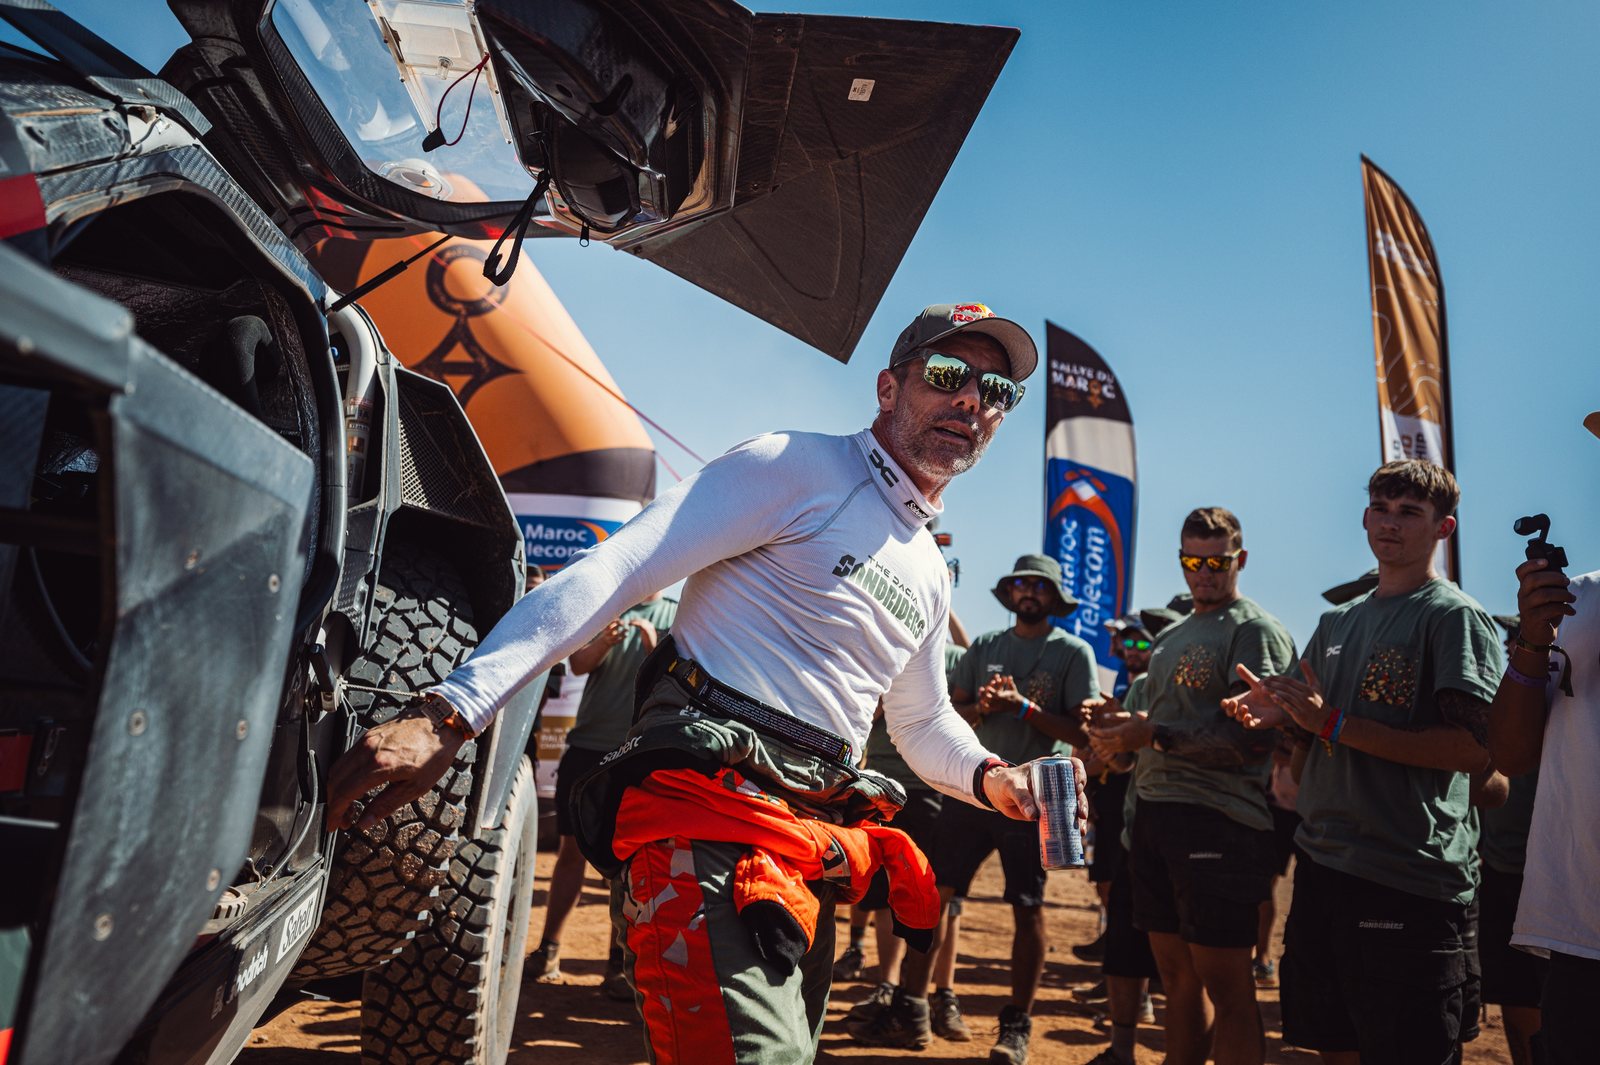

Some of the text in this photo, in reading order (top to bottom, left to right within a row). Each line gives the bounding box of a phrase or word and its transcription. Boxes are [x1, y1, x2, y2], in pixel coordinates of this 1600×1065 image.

[1051, 360, 1095, 379] RALLYE
[525, 524, 587, 542] Maroc
[525, 541, 586, 558] leco
[868, 555, 919, 606] THE DACIA
